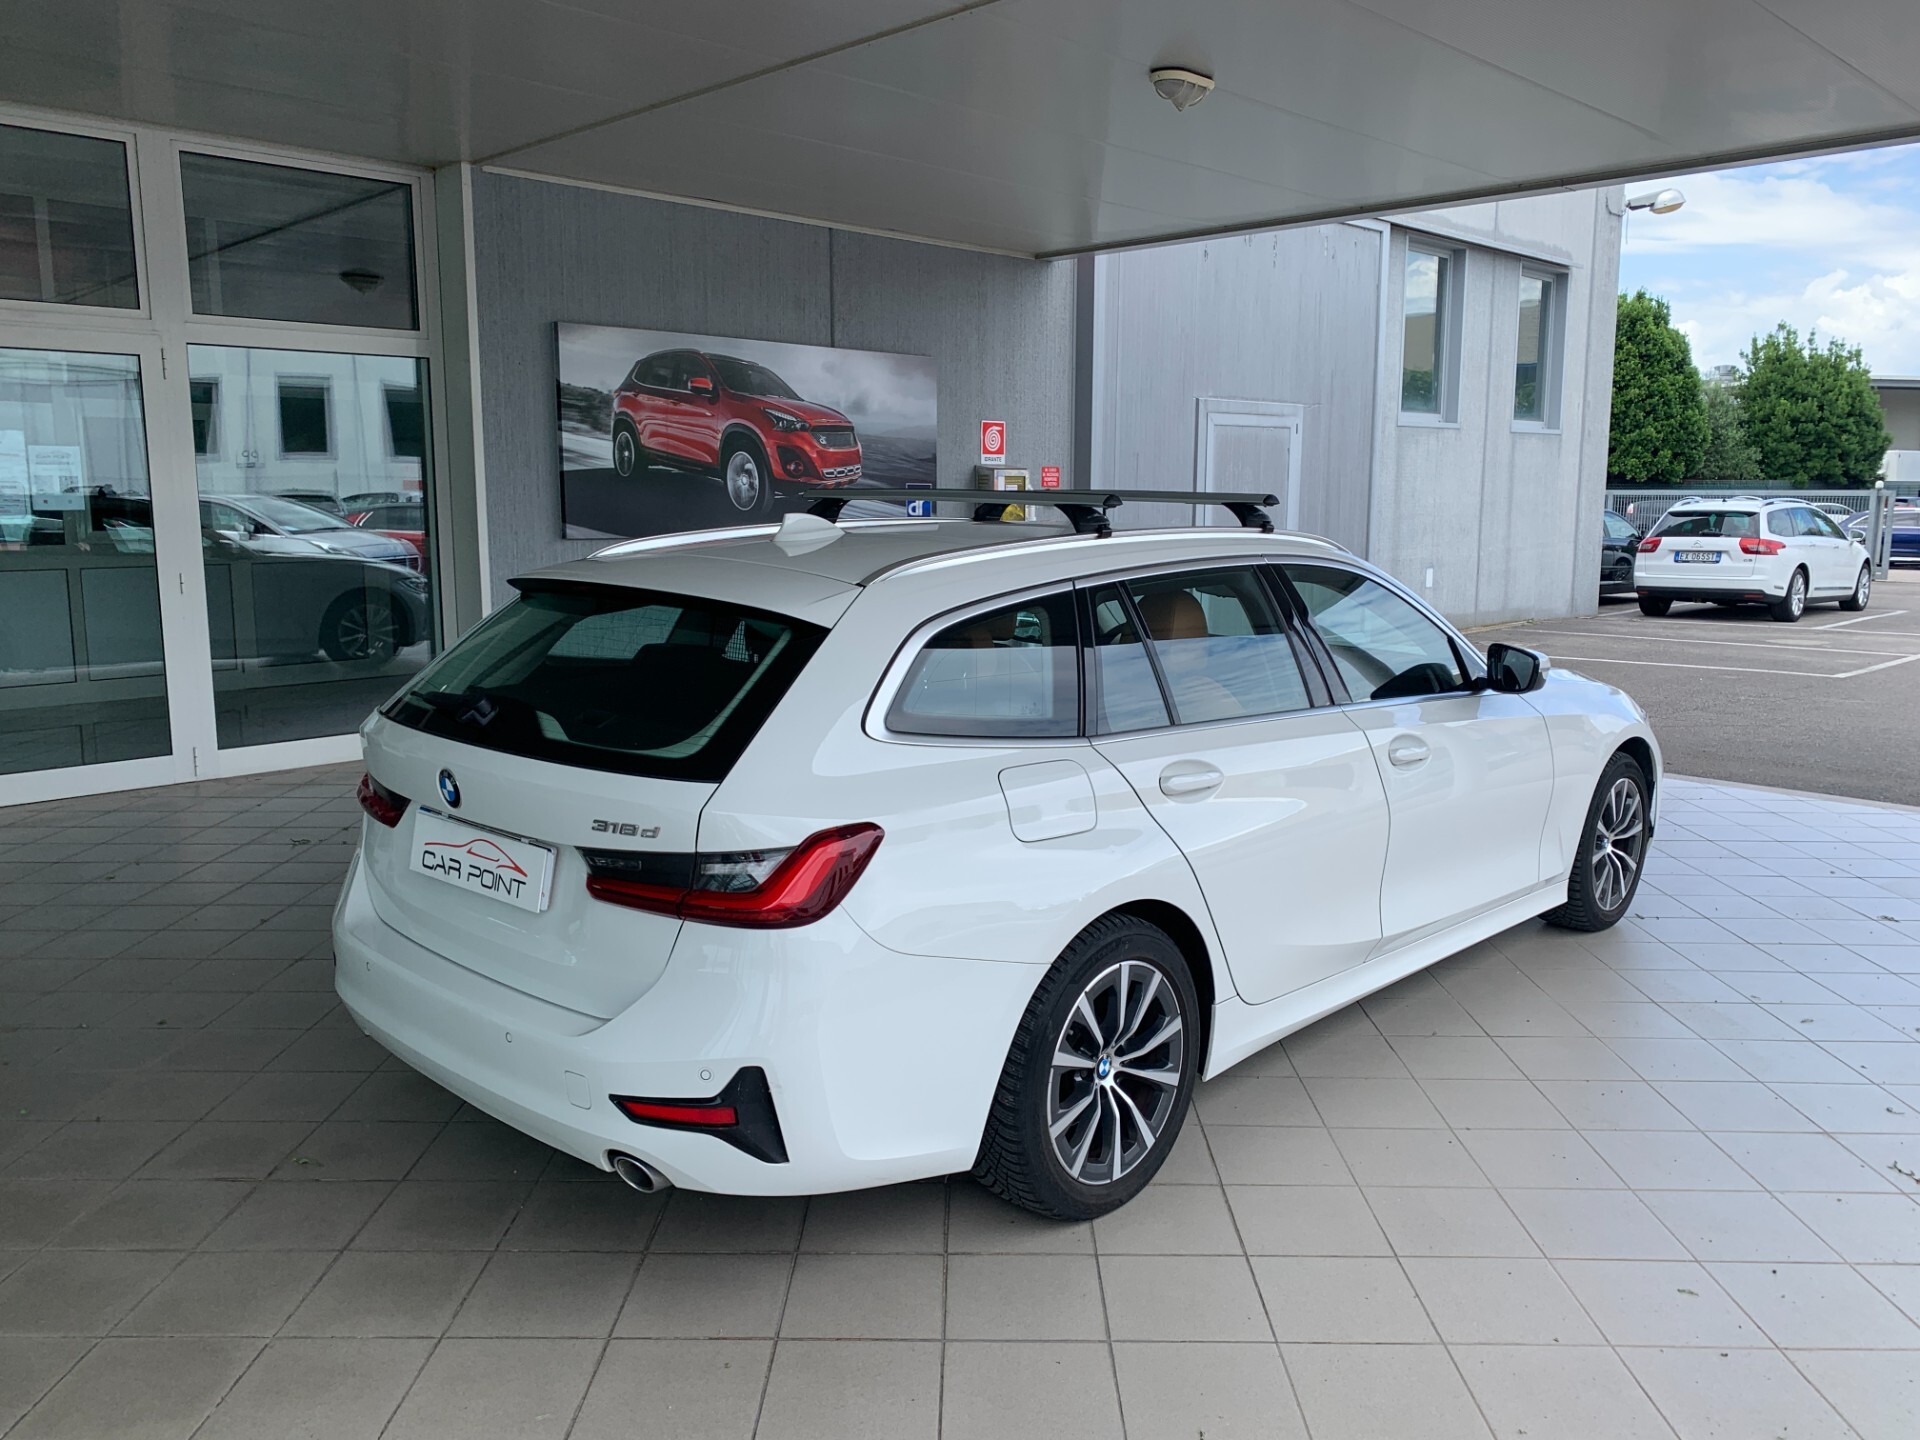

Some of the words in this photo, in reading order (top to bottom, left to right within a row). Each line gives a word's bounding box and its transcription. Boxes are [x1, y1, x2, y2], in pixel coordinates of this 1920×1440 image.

[1679, 552, 1690, 560] EX
[421, 850, 461, 879] CAR
[466, 864, 526, 899] POINT
